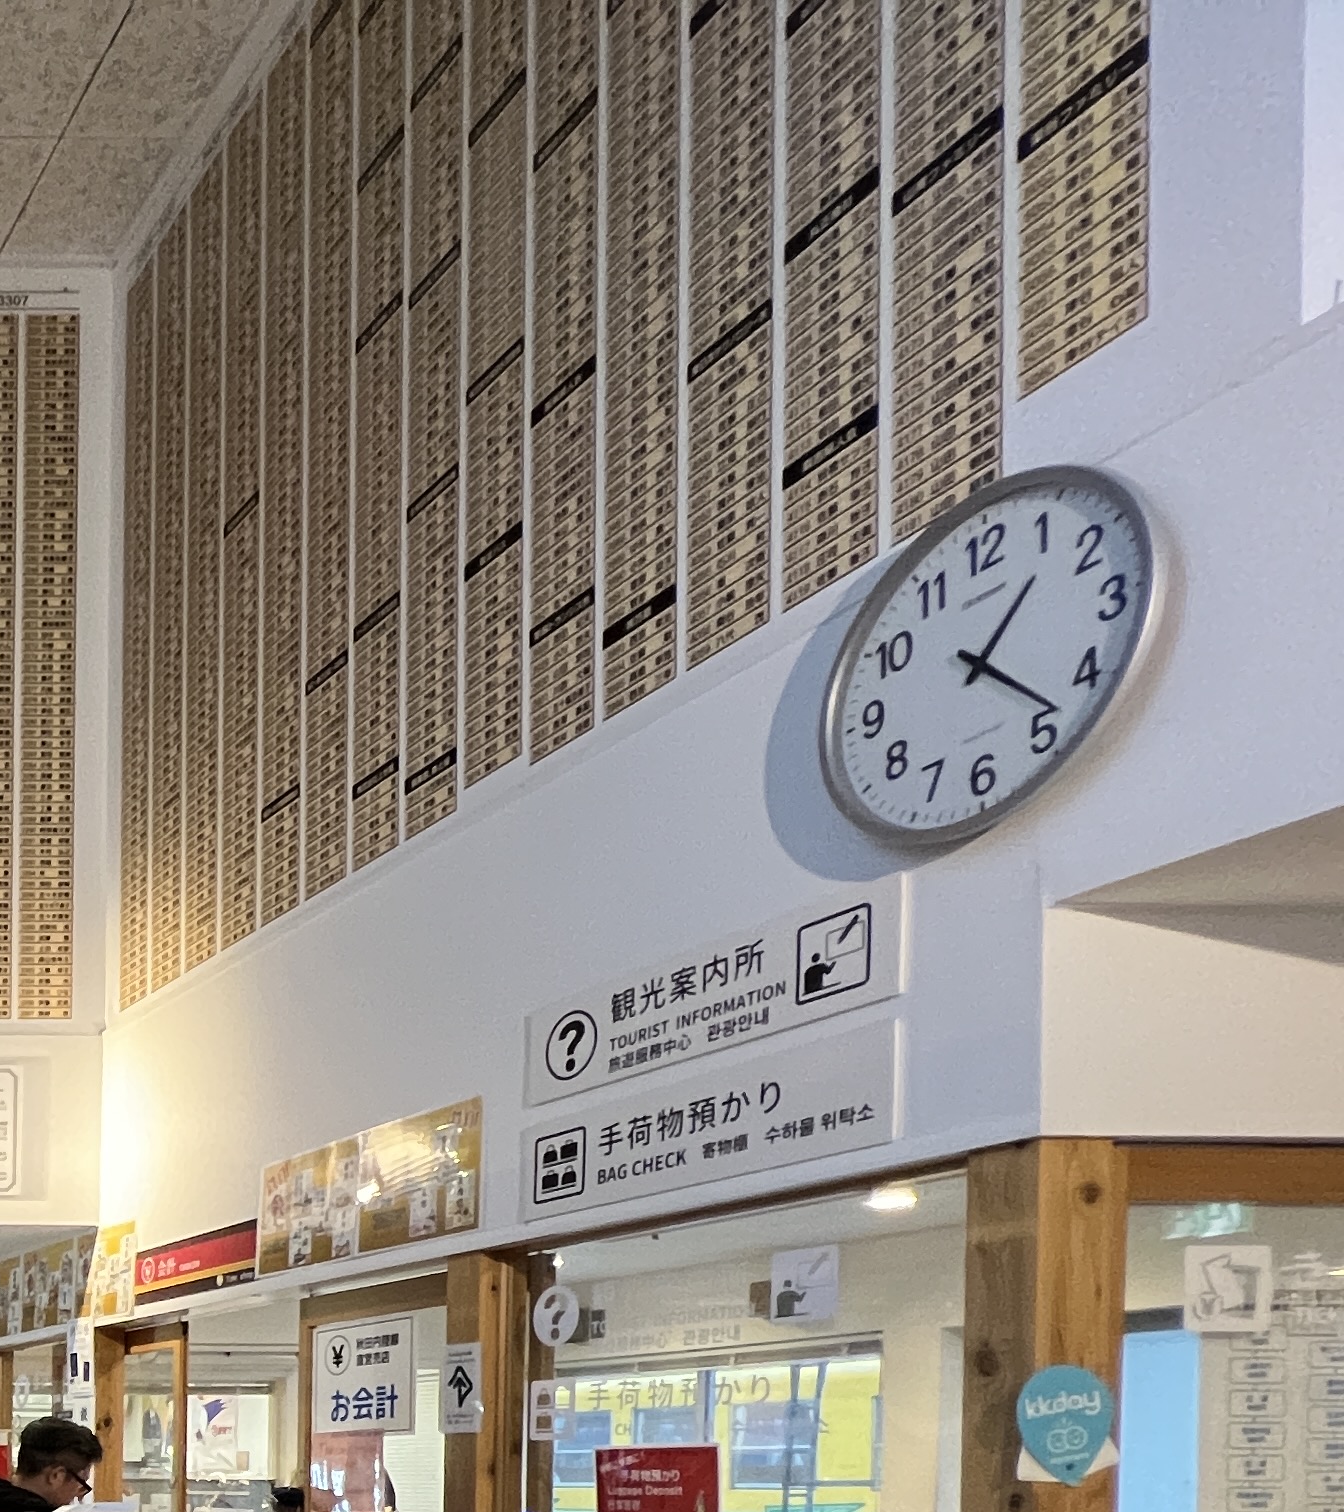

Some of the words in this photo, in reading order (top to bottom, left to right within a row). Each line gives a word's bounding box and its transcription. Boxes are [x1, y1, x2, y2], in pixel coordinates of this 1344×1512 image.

[965, 523, 1006, 577] 12
[1035, 511, 1049, 554] 1
[1075, 524, 1104, 575] 2
[917, 571, 946, 619] 11
[1098, 574, 1127, 621] 3
[875, 630, 913, 678] 10
[1072, 646, 1101, 690] 4
[862, 700, 885, 739] 9
[1030, 707, 1058, 754] 5
[885, 740, 908, 780] 8
[921, 758, 945, 803] 7
[969, 753, 997, 796] 6
[610, 939, 764, 1024] 観光案内所
[610, 1019, 669, 1052] TOURIST
[676, 981, 787, 1030] INFORMATION
[707, 1006, 770, 1043] 관광안내
[599, 1081, 781, 1157] 手荷物預かり
[821, 1103, 876, 1132] 위탁소
[597, 1161, 628, 1185] BAG
[631, 1150, 687, 1178] CHECK
[331, 1384, 399, 1422] お会計
[1025, 1390, 1101, 1419] kkday
